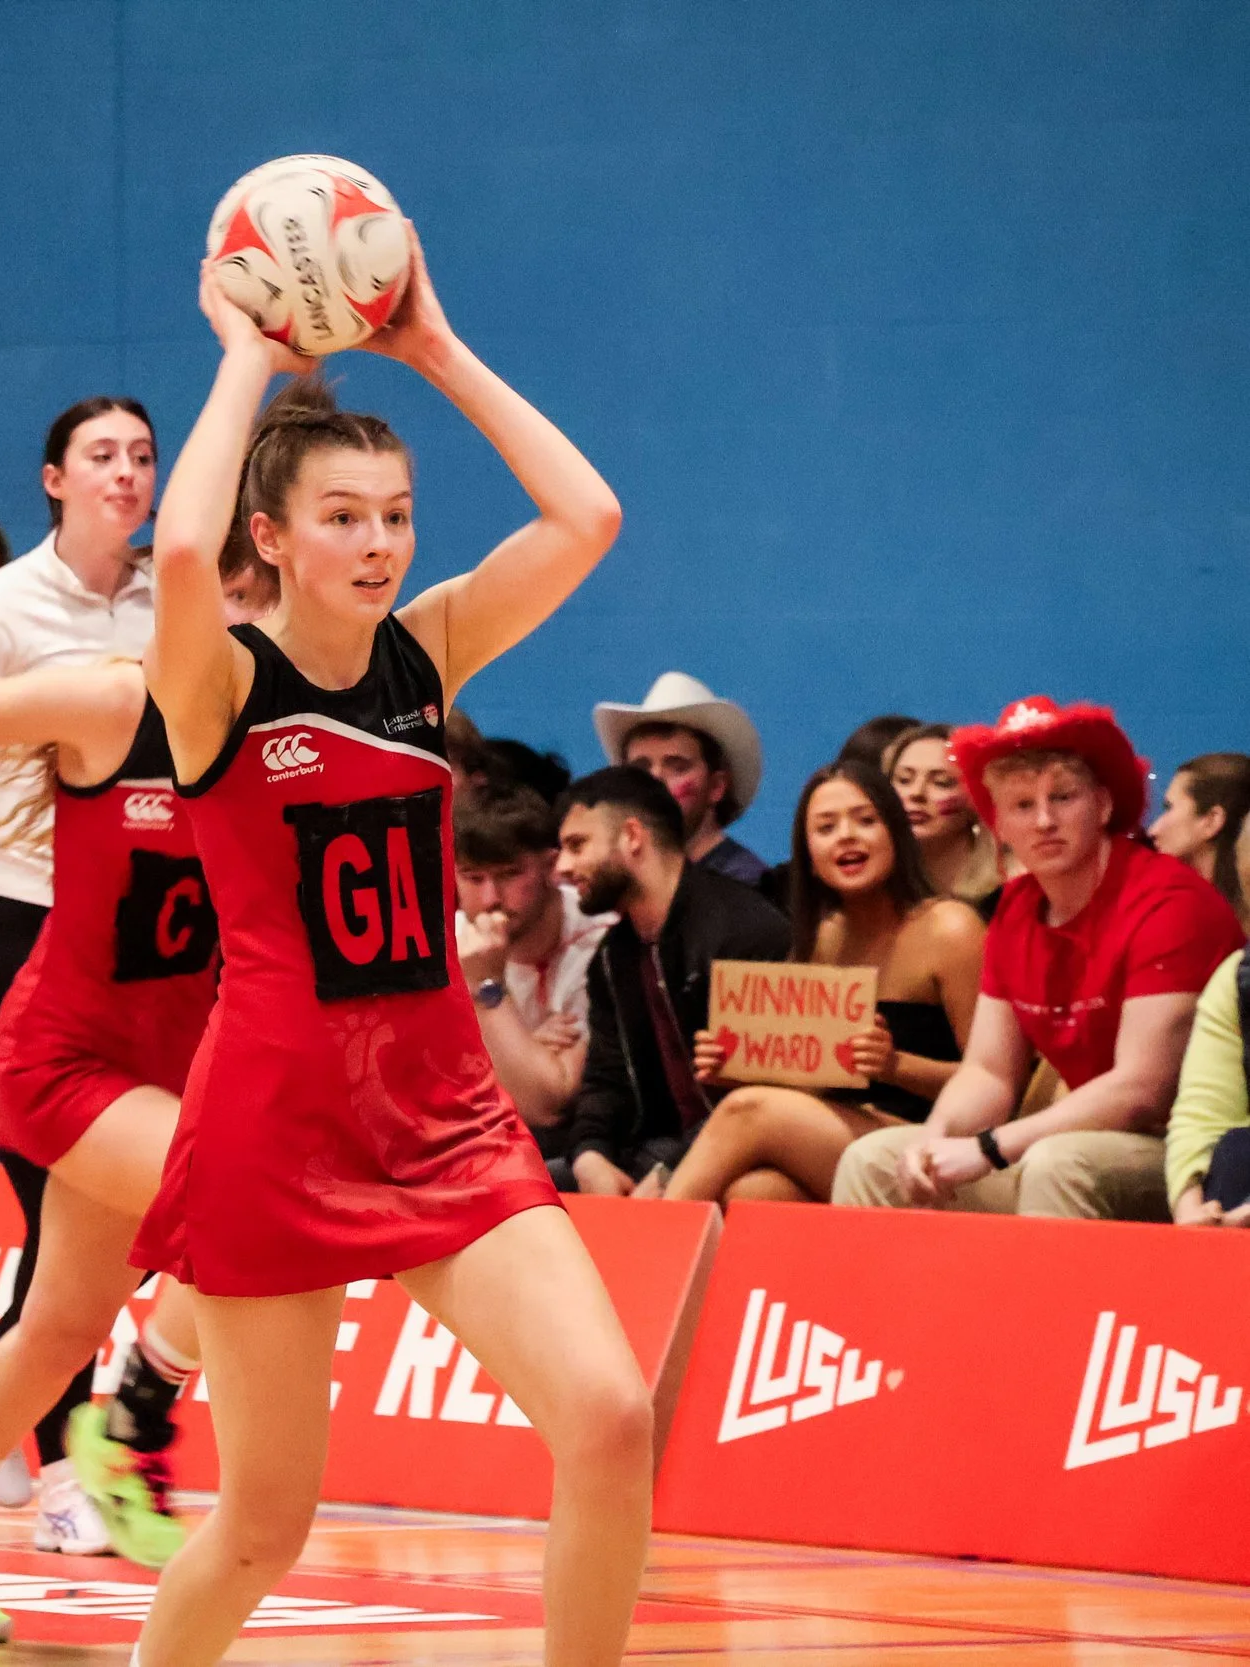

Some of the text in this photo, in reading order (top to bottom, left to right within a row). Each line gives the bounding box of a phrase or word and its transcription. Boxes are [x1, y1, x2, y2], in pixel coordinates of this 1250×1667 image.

[282, 215, 335, 341] LANCASTER
[266, 762, 325, 783] canterbury
[321, 826, 432, 966] GA
[717, 970, 867, 1023] WINNING
[743, 1032, 823, 1074] WARD
